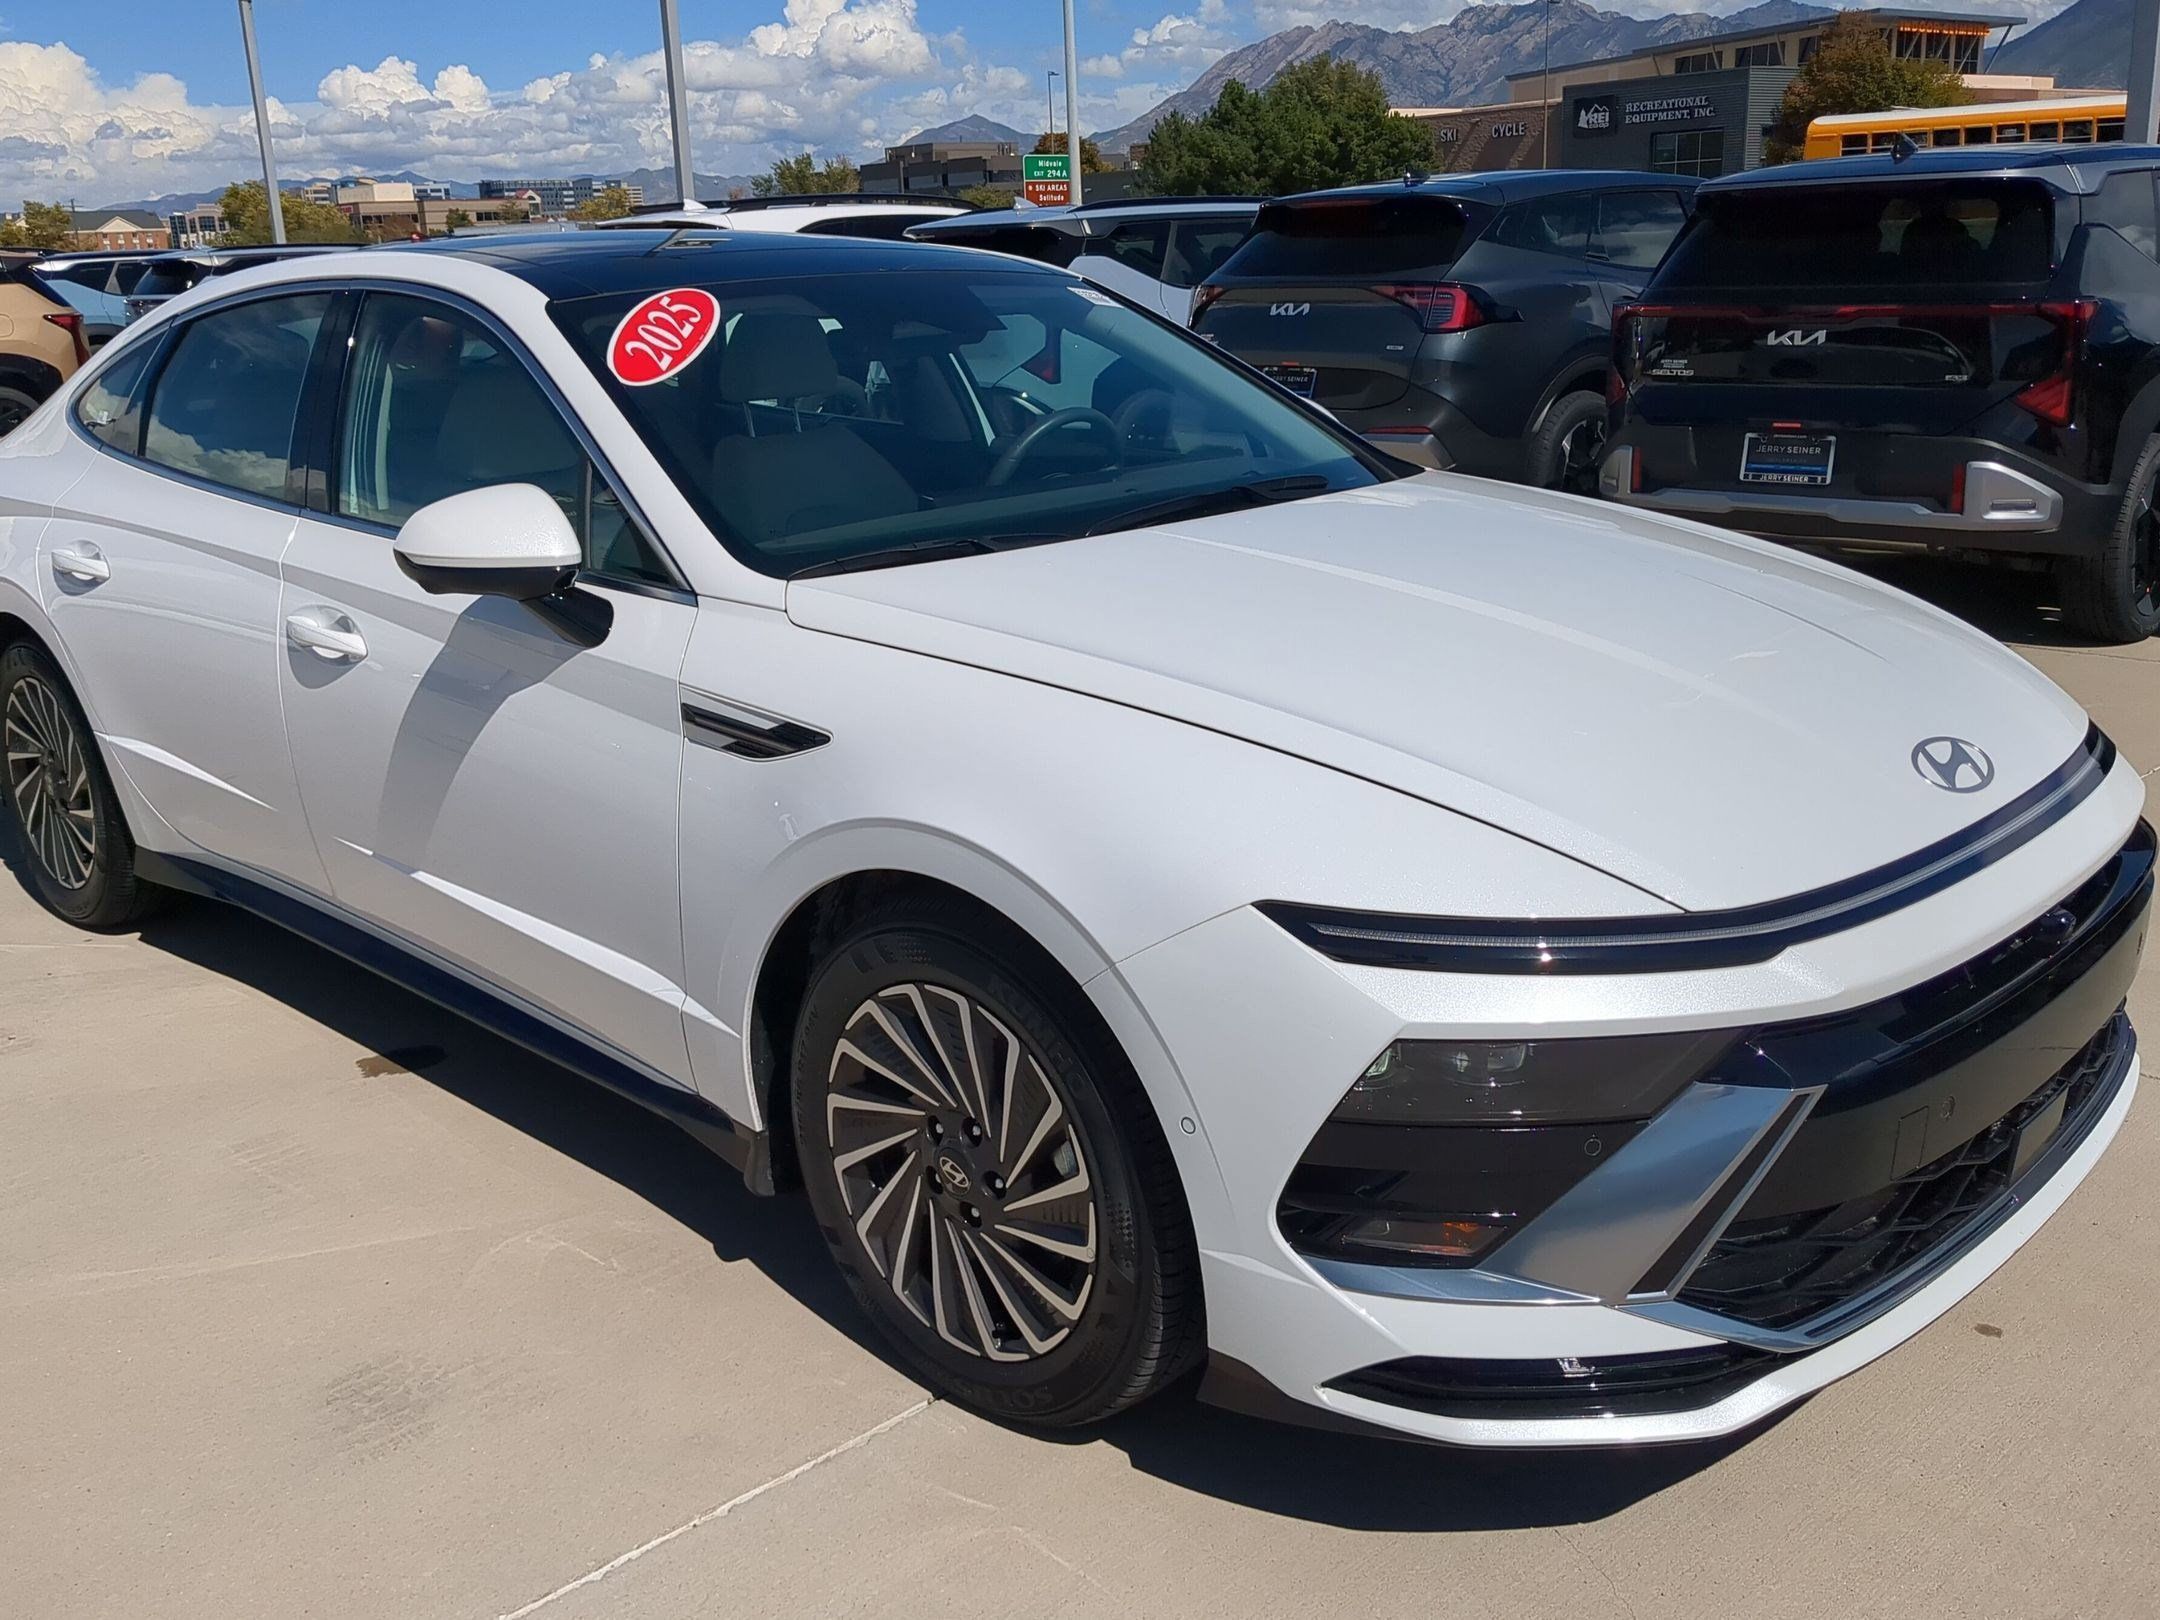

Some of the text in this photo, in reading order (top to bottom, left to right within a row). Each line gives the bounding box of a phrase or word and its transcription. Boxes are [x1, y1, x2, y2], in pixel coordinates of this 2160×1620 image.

[1626, 96, 1708, 112] RECREATIONAL
[1589, 112, 1609, 123] REI
[1625, 107, 1715, 124] EQUIPMENT, INC.
[1440, 128, 1457, 142] SKI
[1492, 122, 1525, 138] CYCLE
[624, 295, 702, 372] 2025
[1756, 445, 1821, 454] JERRY SEINER
